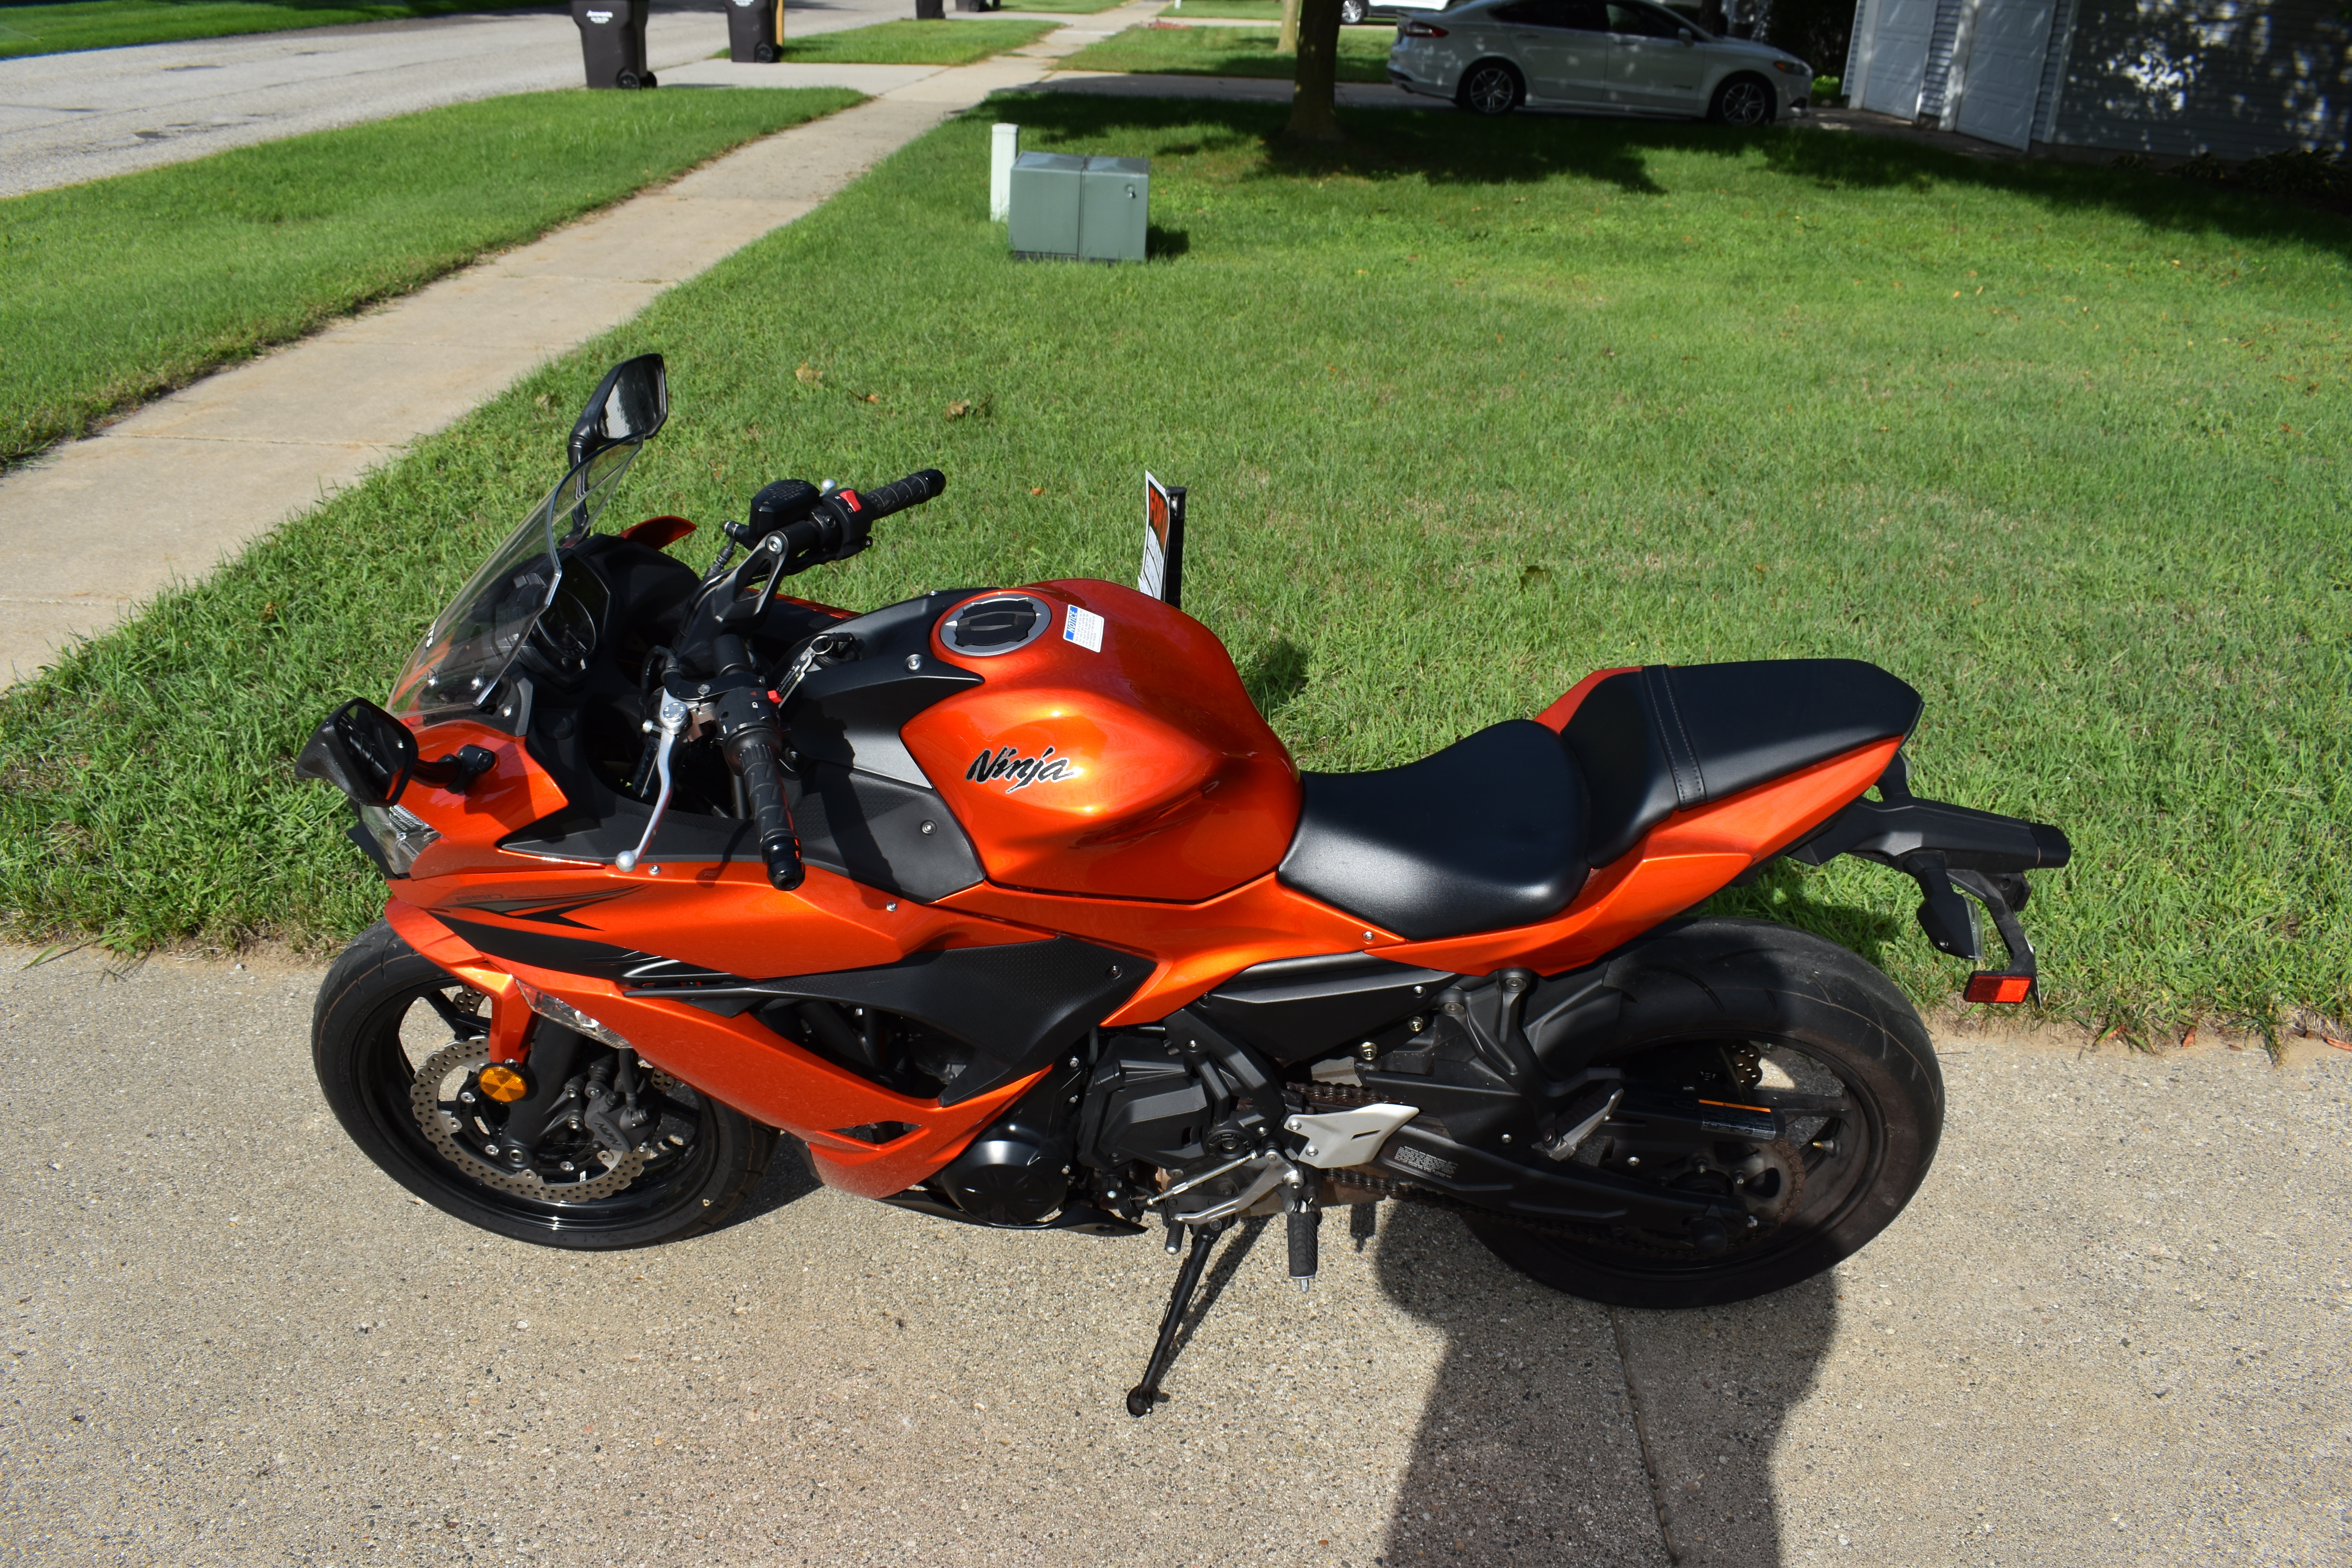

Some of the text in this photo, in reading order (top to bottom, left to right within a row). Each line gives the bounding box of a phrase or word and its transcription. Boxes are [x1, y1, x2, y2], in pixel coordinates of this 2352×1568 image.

[1150, 486, 1163, 534] FOR
[1067, 610, 1077, 633] NOTICE
[965, 745, 1077, 794] Ninja
